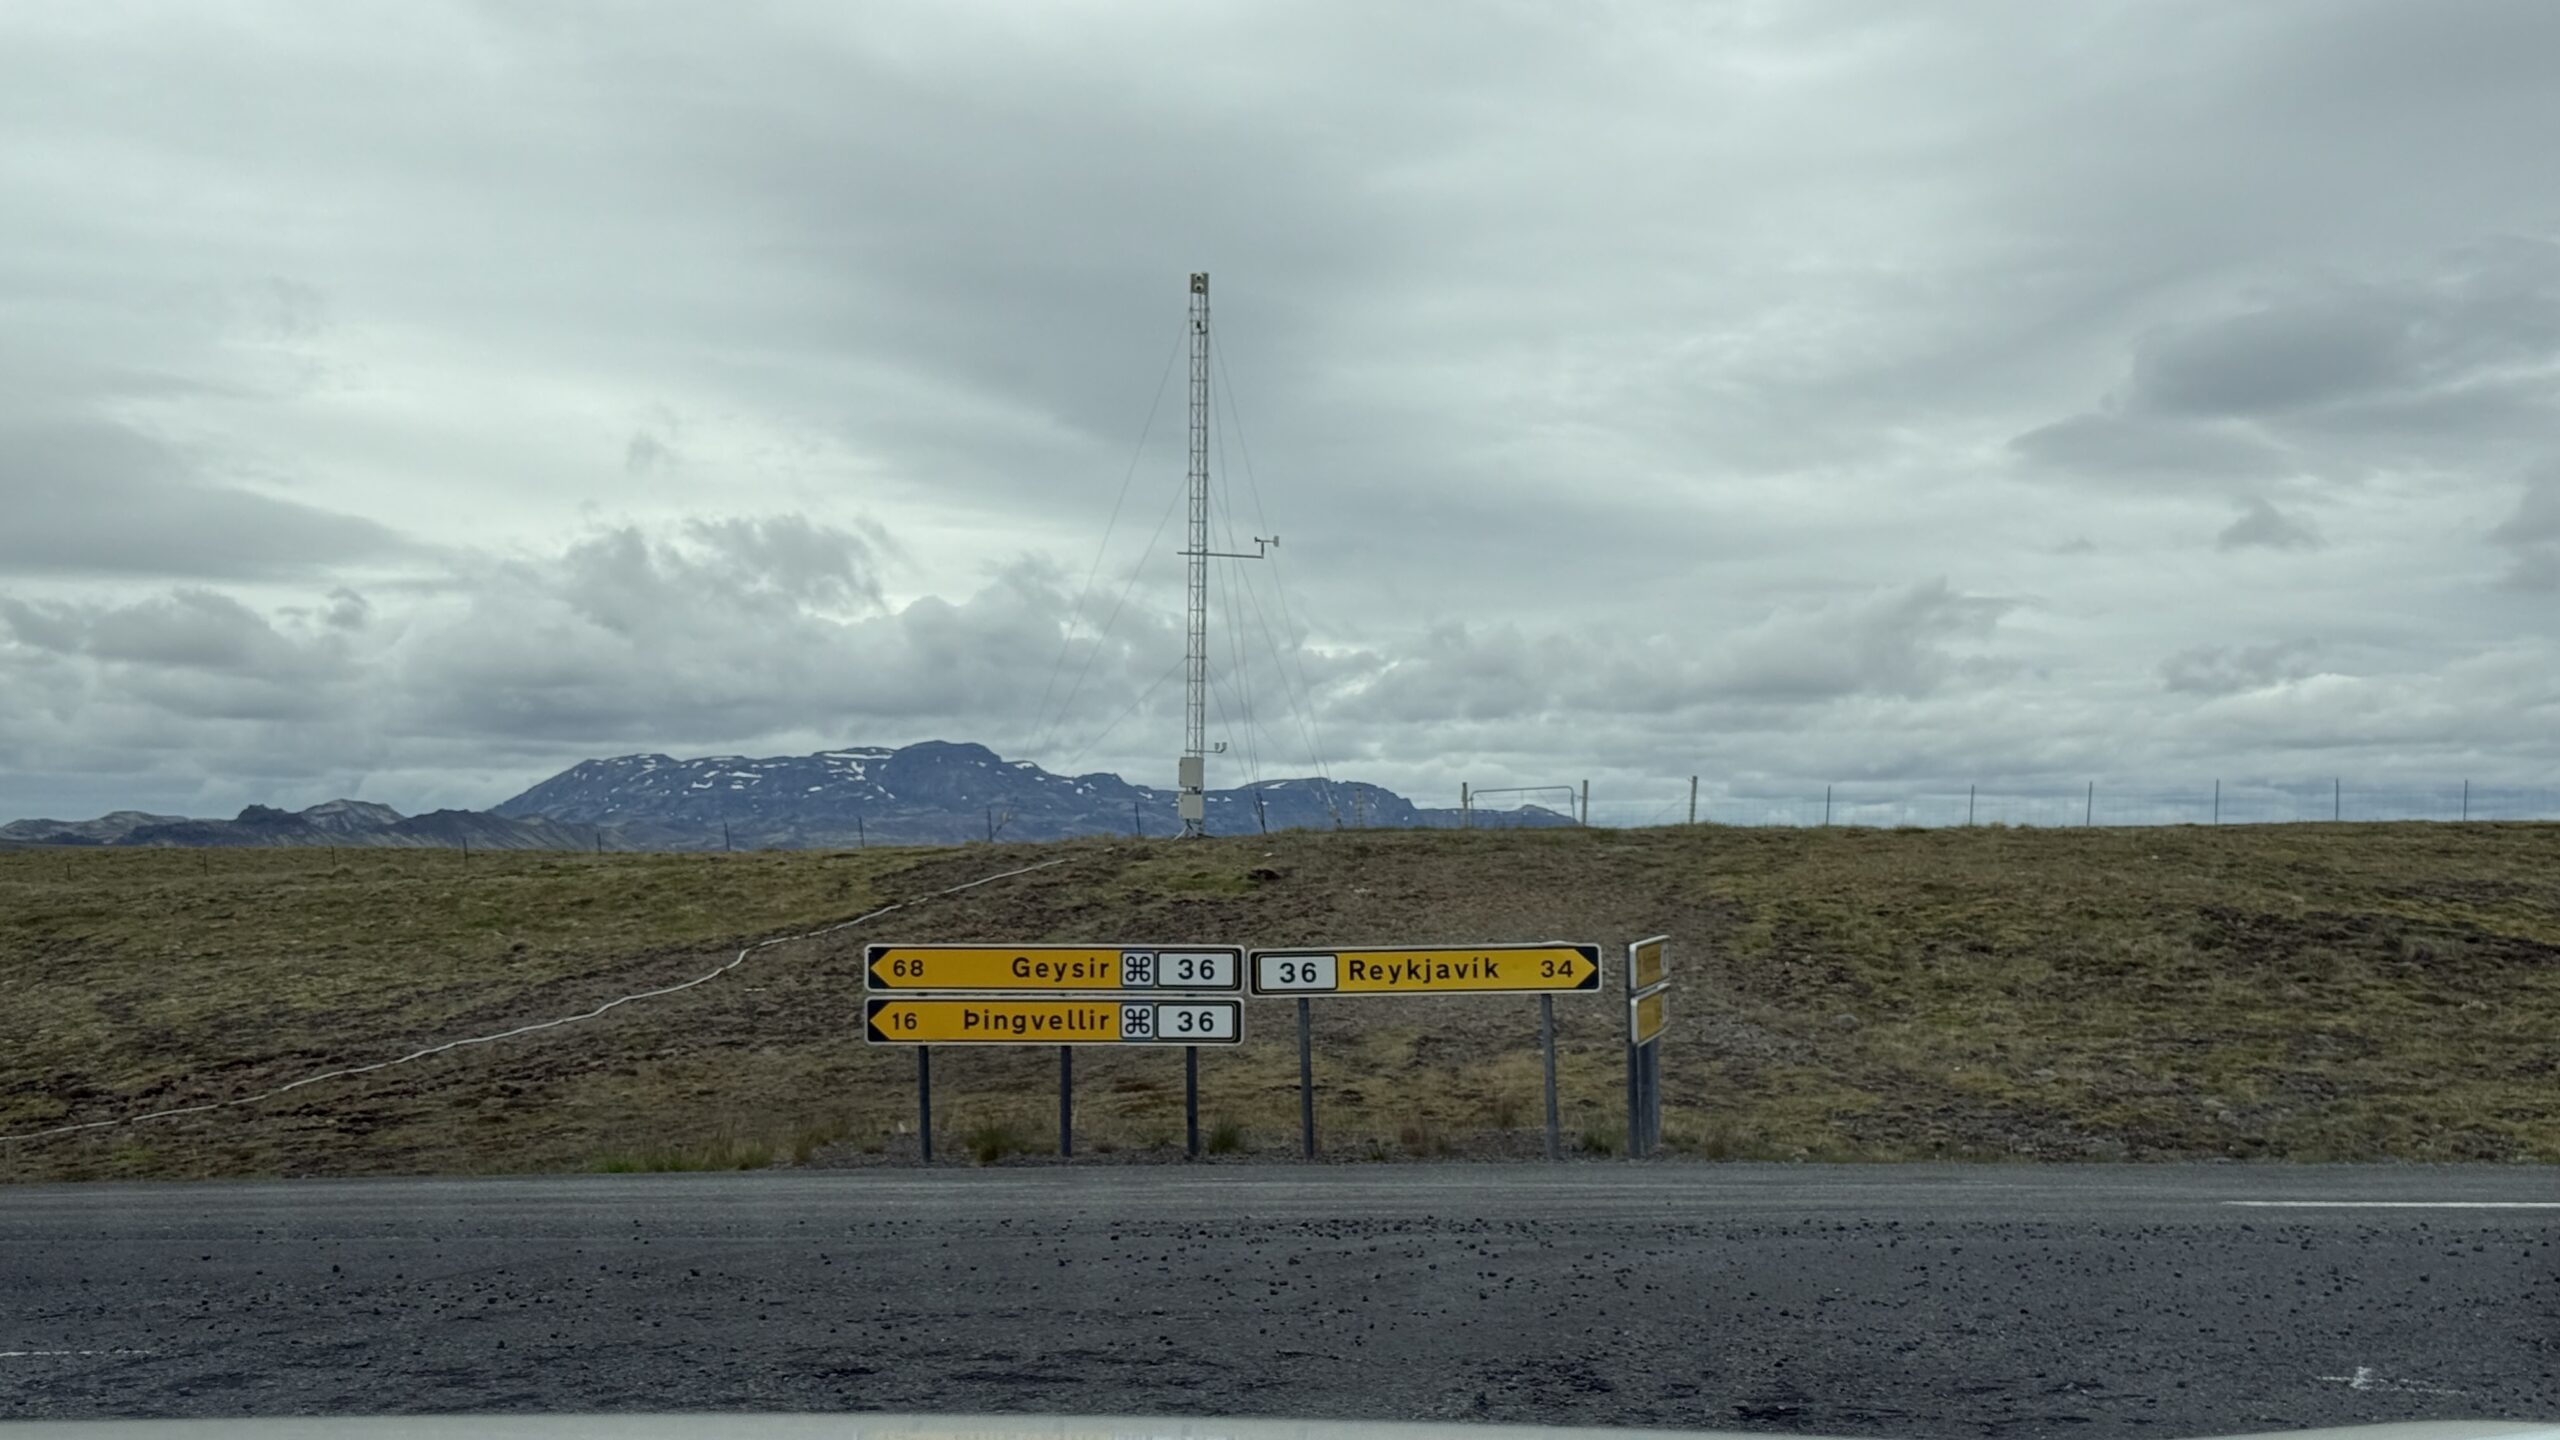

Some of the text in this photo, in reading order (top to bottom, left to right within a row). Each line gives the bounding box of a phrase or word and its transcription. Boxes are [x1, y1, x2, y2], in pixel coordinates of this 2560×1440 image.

[893, 957, 1215, 982] 68 Geysir 36
[1279, 957, 1574, 984] 36 Reykjavík 34
[892, 1009, 1214, 1034] 16 Þingvellir 36
